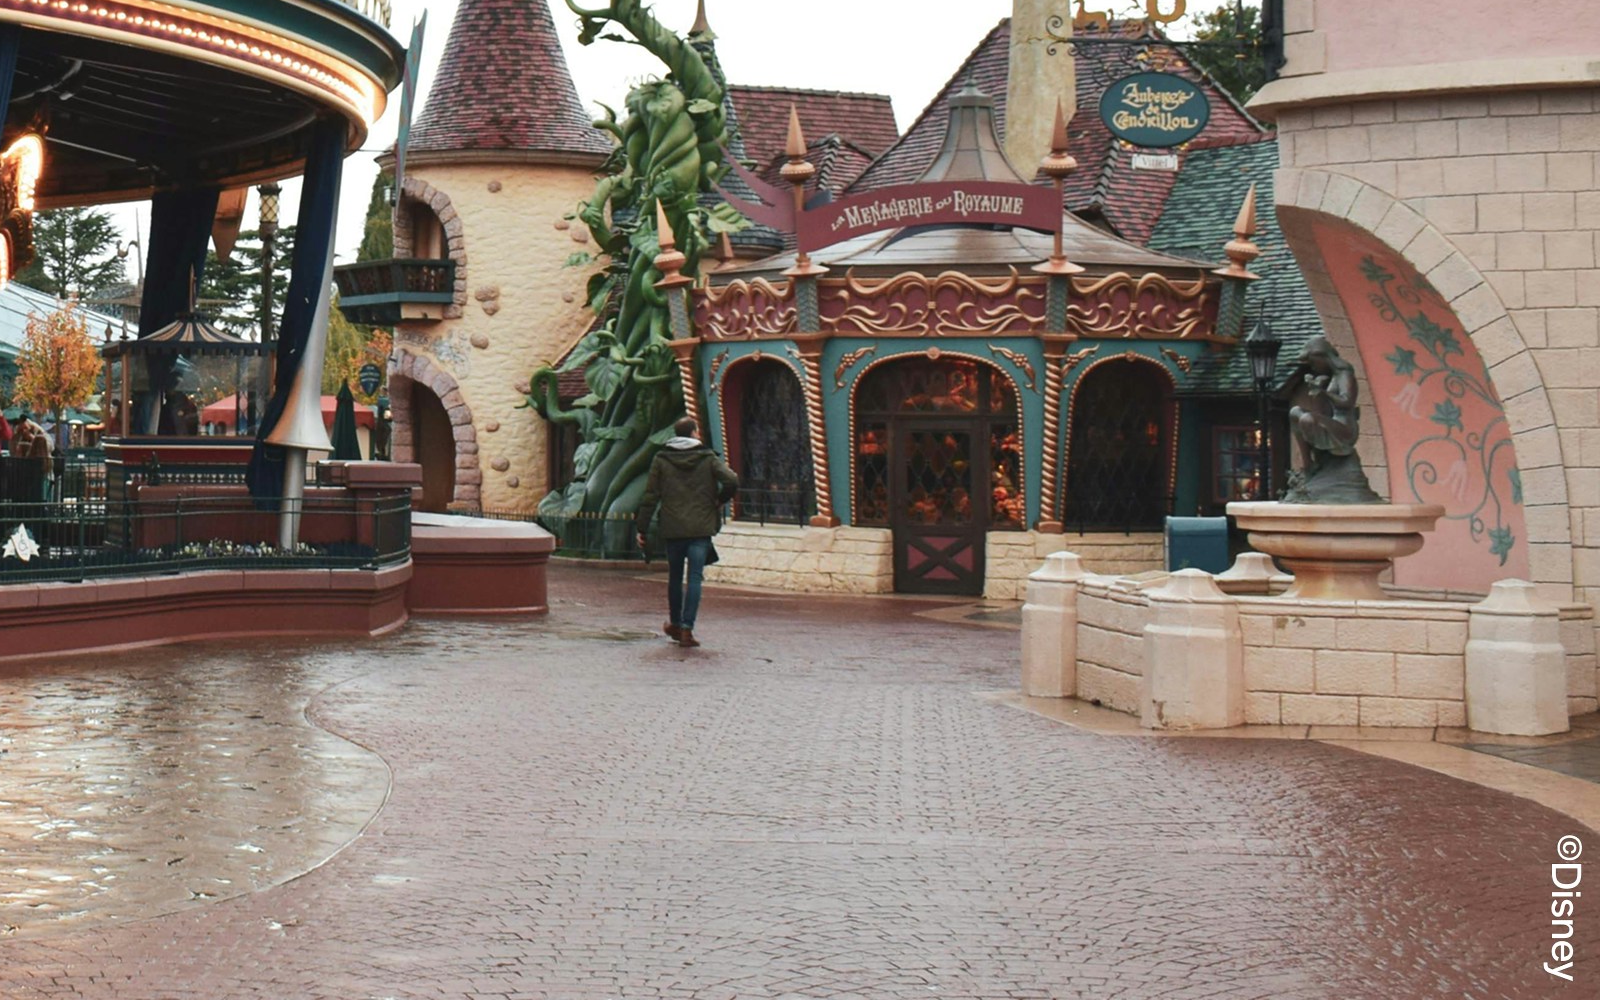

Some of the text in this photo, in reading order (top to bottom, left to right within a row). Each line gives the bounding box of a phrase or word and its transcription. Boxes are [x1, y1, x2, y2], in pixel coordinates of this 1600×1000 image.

[1112, 109, 1199, 132] Cendrillon
[1145, 102, 1160, 116] de
[830, 190, 1024, 232] LA MENAGERIE DU ROYAUME
